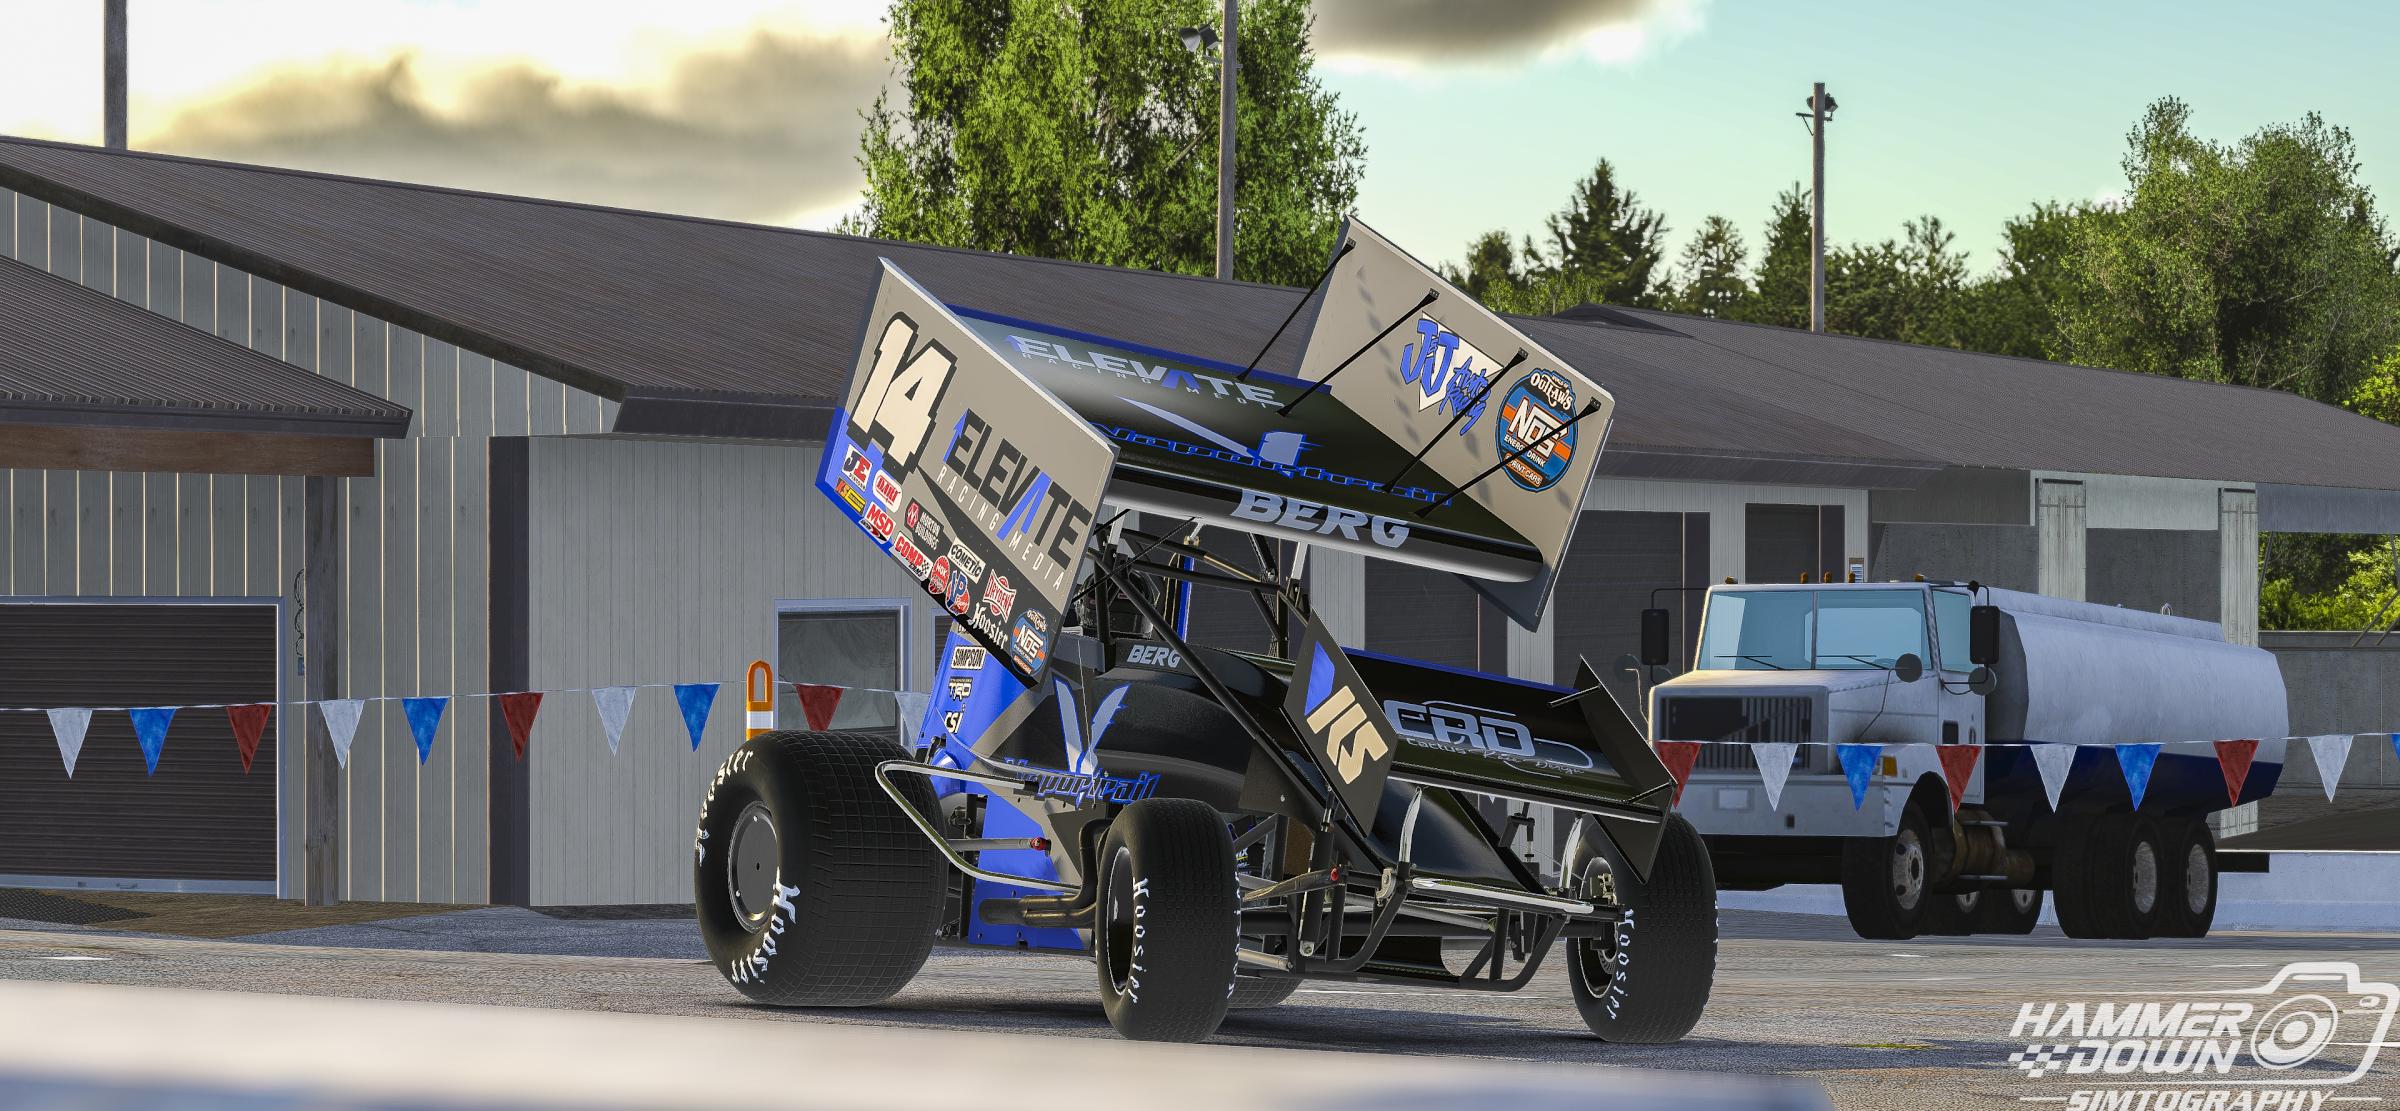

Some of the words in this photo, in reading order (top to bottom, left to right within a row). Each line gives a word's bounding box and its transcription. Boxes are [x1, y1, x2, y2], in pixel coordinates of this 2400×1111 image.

[1006, 335, 1285, 407] ELEVATE
[849, 312, 957, 483] 14
[1185, 386, 1278, 414] MEDI
[1508, 398, 1568, 458] NOS
[844, 451, 872, 483] JE
[1503, 434, 1526, 452] ENERG
[1526, 450, 1547, 467] DRINK
[944, 408, 1092, 570] ELEVATE
[1525, 469, 1542, 486] CARS
[866, 504, 894, 537] MSD
[936, 466, 1000, 531] RACING
[1008, 531, 1065, 590] MEDIA
[1231, 488, 1410, 548] BERG
[895, 535, 924, 567] COMP
[951, 545, 982, 578] COMETIC
[967, 602, 1009, 650] Hoosier
[1015, 624, 1044, 659] NOS
[952, 647, 986, 668] SIMPSON
[1126, 644, 1182, 668] BERG
[731, 866, 801, 984] Hoosier
[1127, 876, 1150, 1004] Hoosier
[1606, 908, 1635, 1020] Hoosier
